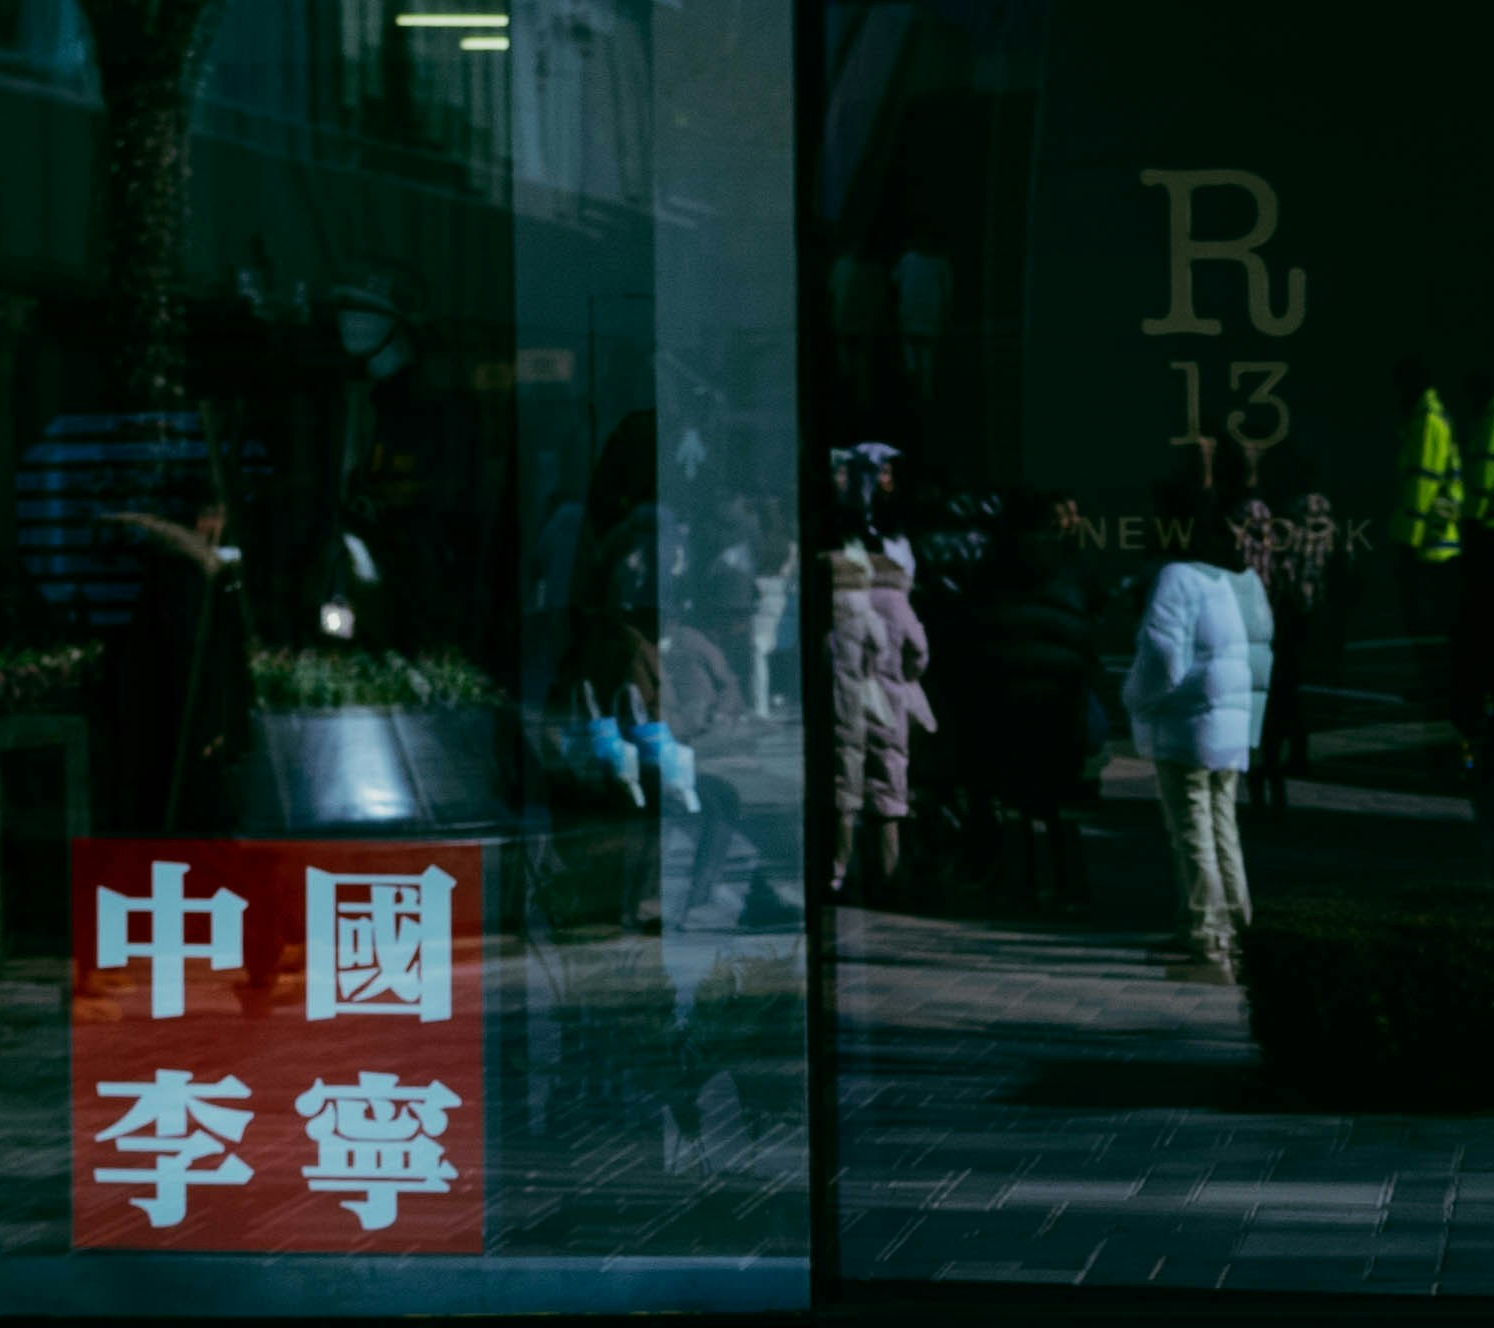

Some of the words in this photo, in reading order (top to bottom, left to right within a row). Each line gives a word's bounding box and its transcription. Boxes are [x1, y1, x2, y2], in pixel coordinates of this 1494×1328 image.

[1138, 167, 1308, 338] R
[1168, 360, 1291, 448] 13
[1078, 515, 1196, 551] NEW
[1223, 514, 1374, 552] YORK
[95, 859, 458, 1023] 中國
[93, 1067, 464, 1232] 李寧
